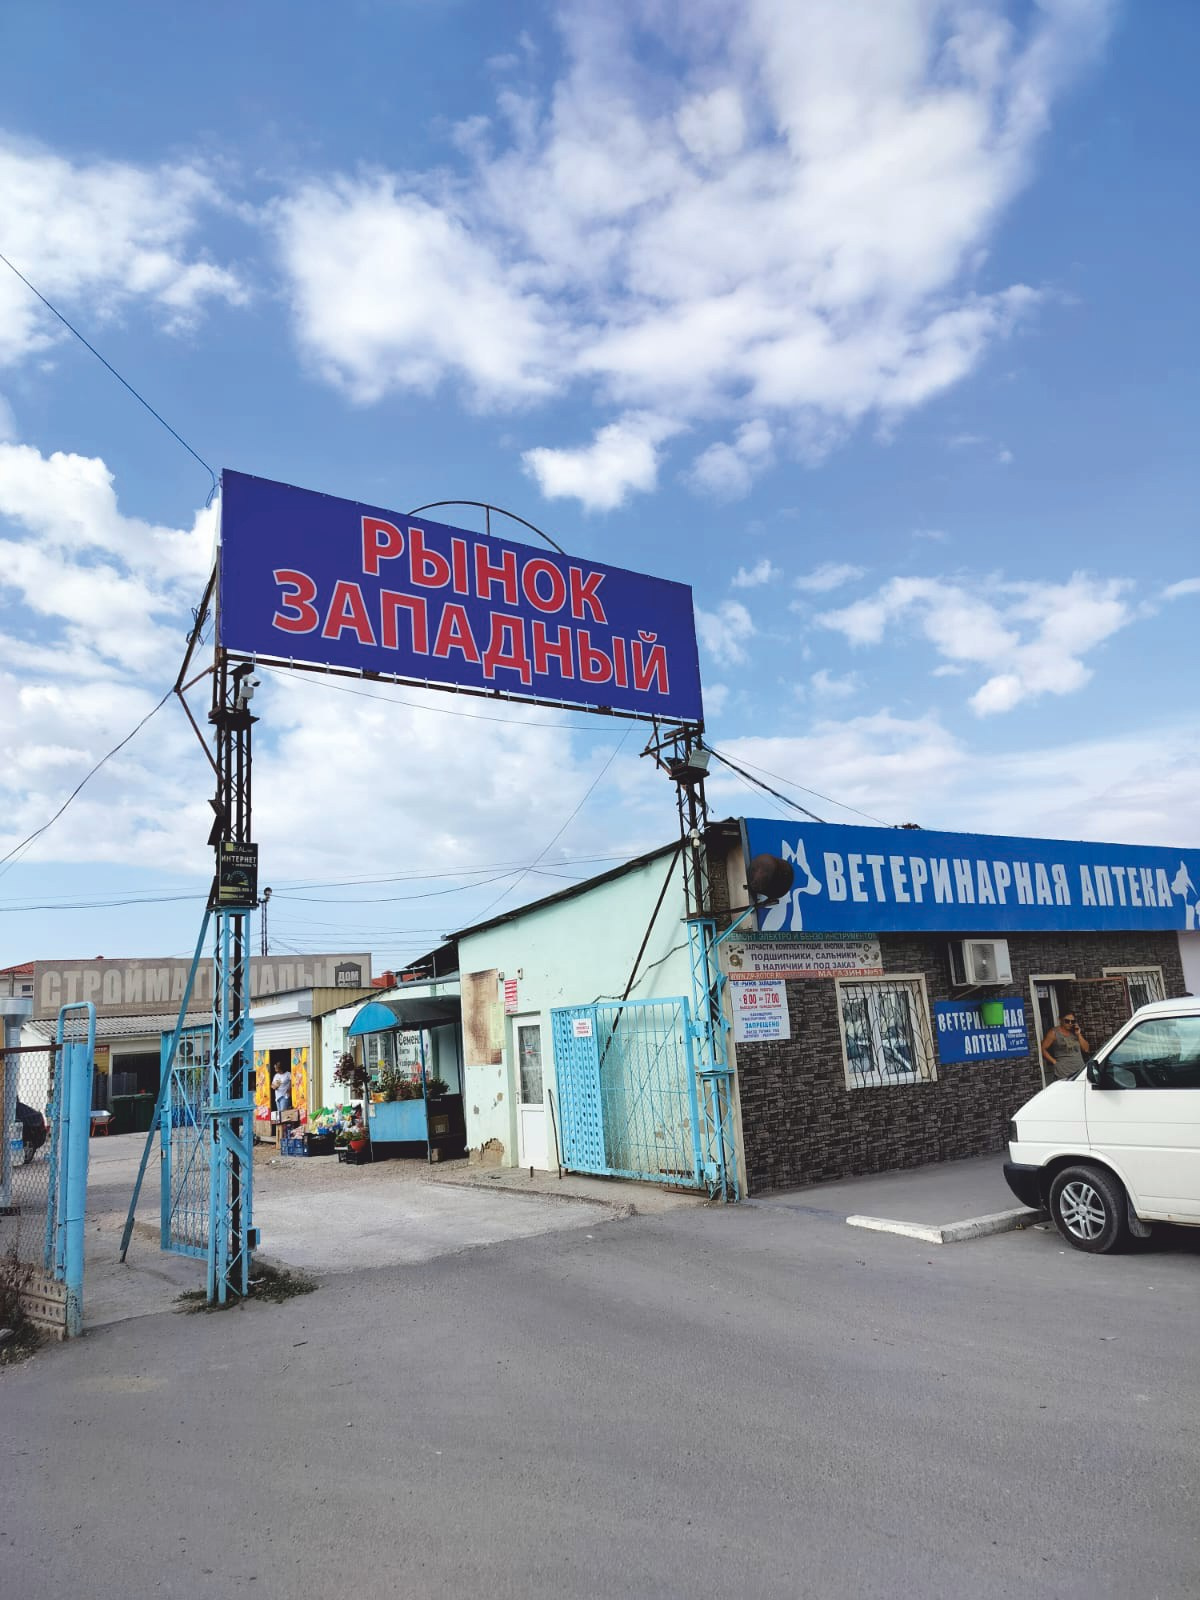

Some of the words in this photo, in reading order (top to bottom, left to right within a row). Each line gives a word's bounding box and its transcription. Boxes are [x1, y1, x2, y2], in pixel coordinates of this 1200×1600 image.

[361, 514, 608, 626] РЫНОК
[271, 567, 671, 696] ЗАПАДНЫЙ
[221, 855, 257, 864] ИНТЕРНЕТ
[823, 851, 1072, 906] ВЕТЕРИНАРНАЯ
[1079, 864, 1175, 908] АПТЕКА
[751, 952, 814, 962] ПОДШИПНИКИ,
[815, 952, 857, 960] САЛЬНИКИ
[762, 963, 804, 971] НАЛИЧИИ
[814, 962, 831, 970] ПОД
[832, 961, 856, 969] ЗАКАЗ
[818, 969, 862, 977] МАГАЗИН
[337, 970, 359, 982] ДОМ
[937, 1008, 1025, 1033] ВЕТЕРИНАЯ
[964, 1033, 1008, 1055] АПТЕКА
